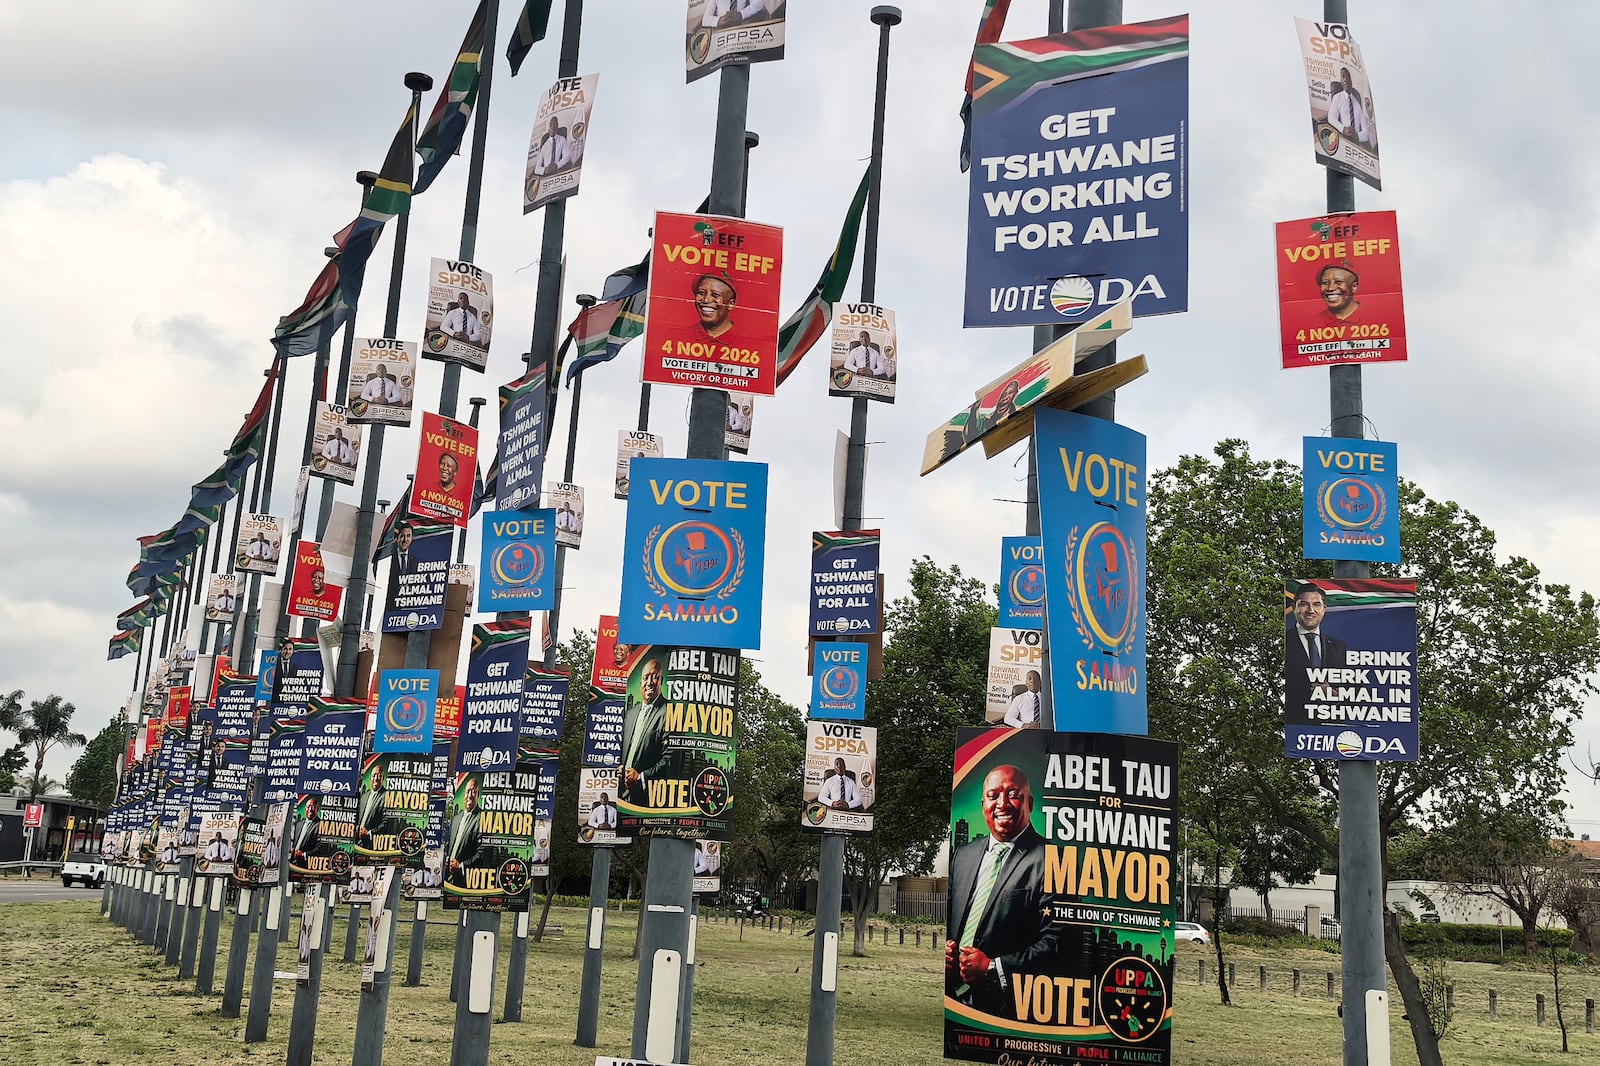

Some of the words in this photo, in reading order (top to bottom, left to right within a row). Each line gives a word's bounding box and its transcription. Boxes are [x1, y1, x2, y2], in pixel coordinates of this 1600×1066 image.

[717, 28, 774, 47] SPPSA
[549, 77, 582, 98] VOTE
[540, 90, 586, 119] SPPSA
[1040, 107, 1115, 141] GET
[981, 134, 1175, 182] TSHWANE
[983, 172, 1172, 217] WORKING
[995, 221, 1073, 252] FOR
[1082, 212, 1158, 244] ALL
[1334, 225, 1358, 237] EFF
[718, 233, 744, 247] EFF
[1285, 242, 1346, 263] VOTE
[1353, 239, 1391, 256] EFF
[663, 244, 728, 268] VOTE
[735, 253, 774, 274] EFF
[447, 261, 482, 280] VOTE
[438, 272, 488, 295] SPPSA
[990, 284, 1048, 312] VOTE
[1098, 274, 1166, 305] DA
[847, 304, 883, 317] VOTE
[840, 314, 890, 331] SPPSA
[1296, 330, 1305, 342] 4
[1310, 327, 1346, 340] NOV
[1350, 324, 1389, 338] 2026
[368, 339, 404, 350] VOTE
[453, 345, 482, 358] SPPSA
[662, 340, 672, 354] 4
[677, 342, 716, 358] NOV
[720, 347, 760, 364] 2026
[1301, 345, 1322, 353] VOTE
[360, 349, 410, 362] SPPSA
[665, 359, 688, 368] VOTE
[691, 362, 706, 370] EFF
[672, 371, 706, 382] VICTORY
[709, 375, 720, 384] OR
[722, 377, 748, 387] DEATH
[858, 380, 889, 390] SPPSA
[515, 402, 531, 422] KRY
[452, 429, 464, 438] EFF
[503, 412, 541, 442] TSHWANE
[426, 432, 457, 451] VOTE
[459, 442, 475, 457] EFF
[505, 440, 522, 457] AAN
[523, 430, 537, 446] DIE
[629, 432, 655, 442] VOTE
[624, 439, 659, 452] SPPSA
[501, 454, 524, 474] WERK
[525, 444, 539, 460] VIR
[1317, 450, 1384, 472] VOTE
[506, 464, 532, 487] ALMAL
[1060, 448, 1138, 507] VOTE
[428, 491, 447, 503] NOV
[448, 498, 464, 509] 2026
[650, 480, 747, 509] VOTE
[246, 521, 279, 531] SPPSA
[252, 514, 276, 523] VOTE
[493, 520, 544, 536] VOTE
[1320, 532, 1384, 546] SAMMO
[417, 561, 448, 572] BRINK
[833, 559, 857, 569] GET
[399, 574, 427, 584] WERK
[430, 572, 446, 582] VIR
[814, 571, 875, 582] TSHWANE
[399, 585, 432, 596] ALMAL
[434, 583, 445, 593] IN
[492, 588, 541, 599] SAMMO
[815, 583, 874, 595] WORKING
[320, 599, 334, 609] 2026
[394, 595, 443, 607] TSHWANE
[818, 598, 843, 609] FOR
[846, 595, 869, 607] ALL
[388, 616, 406, 626] STEM
[419, 614, 437, 625] DA
[644, 603, 738, 624] SAMMO
[816, 620, 835, 630] VOTE
[849, 619, 871, 629] DA
[668, 650, 707, 673] ABEL
[713, 652, 736, 677] TAU
[822, 650, 860, 662] VOTE
[1346, 651, 1411, 666] BRINK
[487, 662, 509, 677] GET
[698, 673, 711, 681] FOR
[990, 673, 1021, 681] MAYORAL
[992, 666, 1019, 674] TSHWANE
[1076, 659, 1137, 695] SAMMO
[1306, 668, 1370, 684] WERK
[1374, 670, 1411, 685] VIR
[469, 679, 522, 696] TSHWANE
[666, 681, 734, 706] TSHWANE
[1310, 686, 1384, 702] ALMAL
[1389, 689, 1410, 703] IN
[524, 692, 563, 700] TSHWANE
[468, 699, 519, 715] WORKING
[605, 706, 624, 714] KRY
[819, 701, 856, 709] SAMMO
[665, 703, 733, 737] MAYOR
[1304, 705, 1411, 722] TSHWANE
[324, 724, 346, 733] GET
[468, 720, 490, 734] FOR
[492, 719, 513, 732] ALL
[823, 724, 861, 739] VOTE
[306, 736, 360, 746] TSHWANE
[589, 733, 617, 741] WERK
[1297, 734, 1334, 751] STEM
[1365, 736, 1406, 754] DA
[706, 742, 727, 750] TSHWANE
[815, 736, 868, 754] SPPSA
[306, 748, 357, 758] WORKING
[463, 752, 480, 765] VOTE
[492, 751, 511, 764] DA
[587, 754, 603, 762] STEM
[307, 761, 329, 769] FOR
[332, 761, 352, 770] ALL
[704, 774, 723, 785] UPPA
[1044, 754, 1116, 794] ABEL
[1122, 761, 1171, 800] TAU
[304, 781, 320, 790] VOTE
[332, 782, 350, 791] DA
[648, 779, 689, 807] VOTE
[1099, 796, 1121, 808] FOR
[320, 810, 356, 822] TSHWANE
[832, 815, 866, 824] SPPSA
[1042, 806, 1171, 851] TSHWANE
[1044, 844, 1170, 905] MAYOR
[1054, 907, 1073, 918] THE
[1077, 909, 1099, 920] LION
[1103, 912, 1114, 922] OF
[1117, 913, 1160, 927] TSHWANE
[1115, 968, 1153, 988] UPPA
[1012, 973, 1091, 1027] VOTE
[958, 1035, 990, 1047] UNITED
[1005, 1039, 1062, 1055] PROGRESSIVE
[1077, 1046, 1109, 1059] PEOPLE
[1123, 1051, 1162, 1062] ALLIANCE
